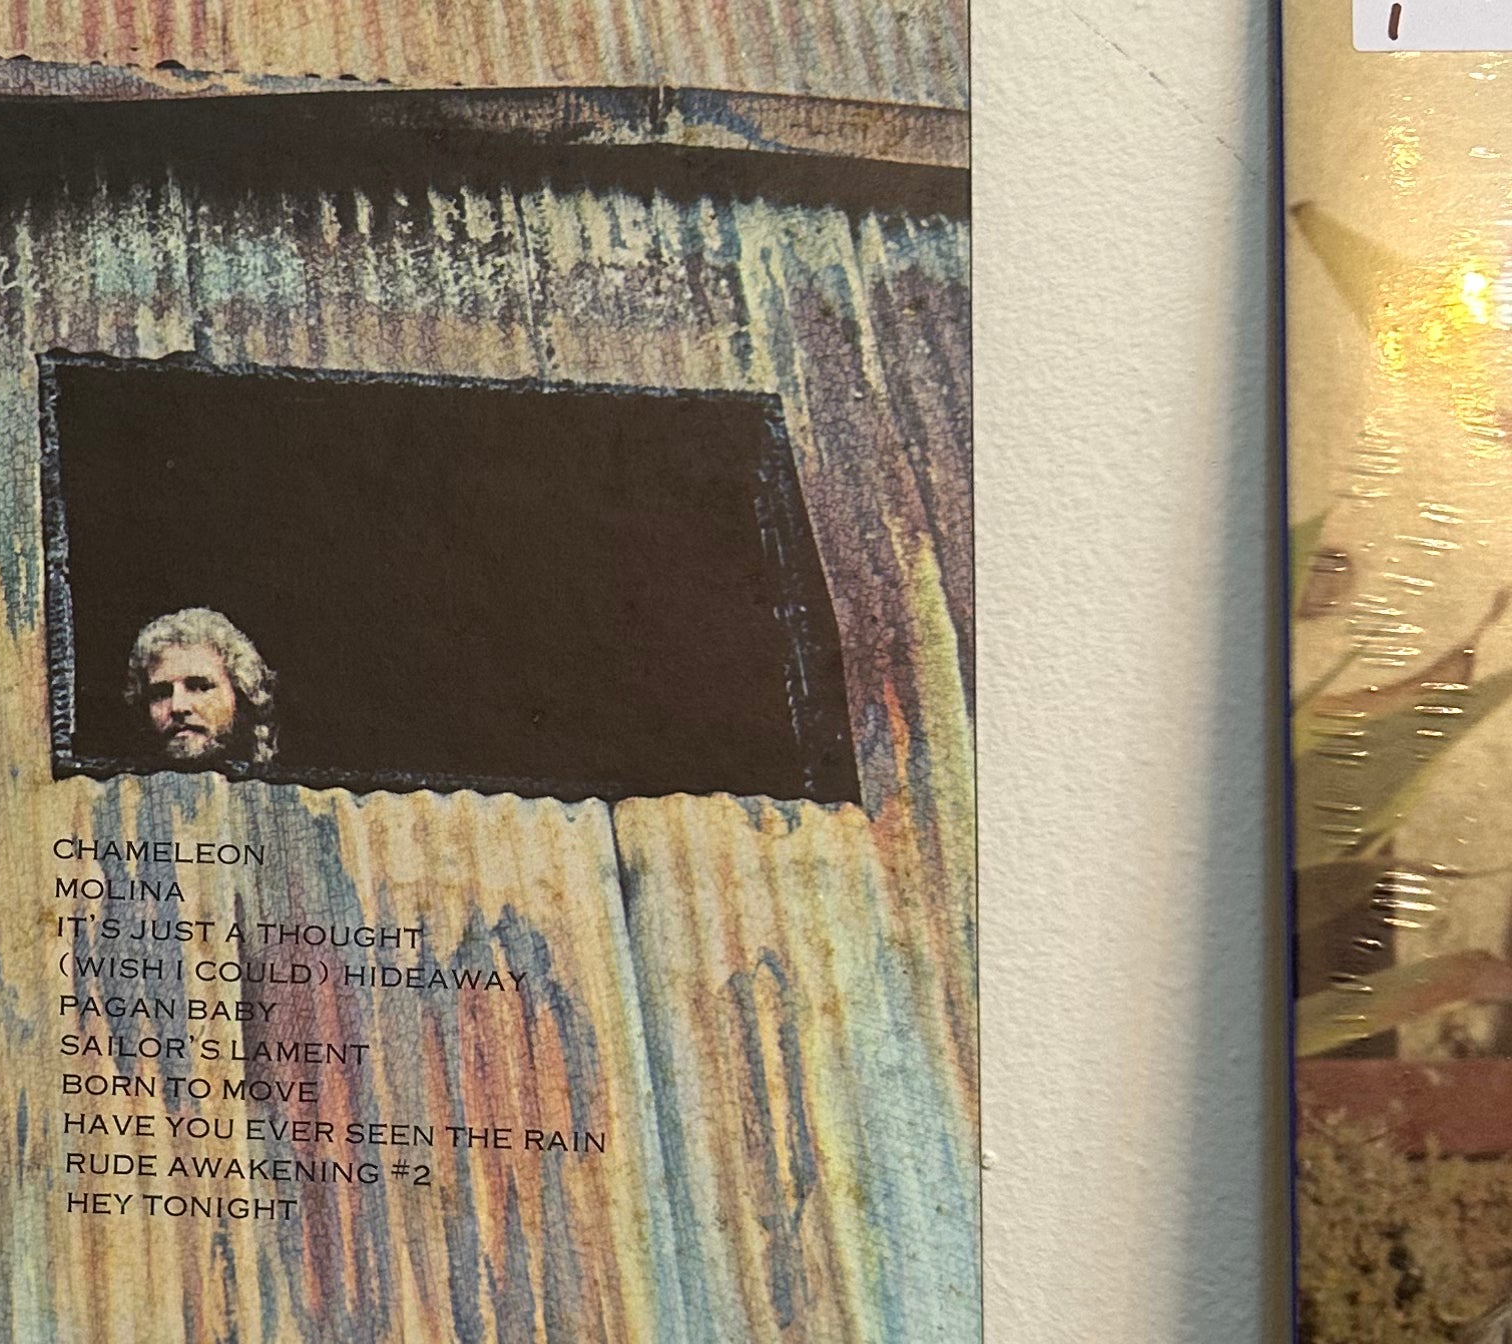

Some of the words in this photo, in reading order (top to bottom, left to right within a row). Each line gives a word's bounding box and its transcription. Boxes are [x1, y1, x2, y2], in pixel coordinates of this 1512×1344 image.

[53, 838, 265, 866] CHAMELEON
[55, 878, 184, 902] MOLINA
[57, 916, 120, 940] IT'S
[130, 920, 215, 943] JUST
[225, 923, 245, 943] A
[257, 923, 424, 950] THOUGHT
[60, 953, 162, 982] (WISH
[177, 960, 182, 981] I
[195, 961, 330, 986] COULD)
[345, 967, 527, 991] HIDEAWAY
[60, 996, 176, 1020] PAGAN
[188, 999, 276, 1021] BABY
[61, 1034, 220, 1058] SAILOR'S
[231, 1040, 369, 1065] LAMENT
[62, 1075, 155, 1098] BORN
[166, 1078, 212, 1100] TO
[223, 1079, 318, 1103] MOVE
[65, 1113, 155, 1137] HAVE
[167, 1116, 234, 1139] YOU
[246, 1121, 335, 1143] EVER
[346, 1123, 434, 1147] SEEN
[445, 1127, 512, 1150] THE
[524, 1129, 606, 1153] RAIN
[66, 1153, 158, 1177] RUDE
[168, 1157, 380, 1184] AWAKENING
[392, 1159, 432, 1186] #2
[67, 1194, 132, 1216] HEY
[143, 1195, 297, 1221] TONIGHT
